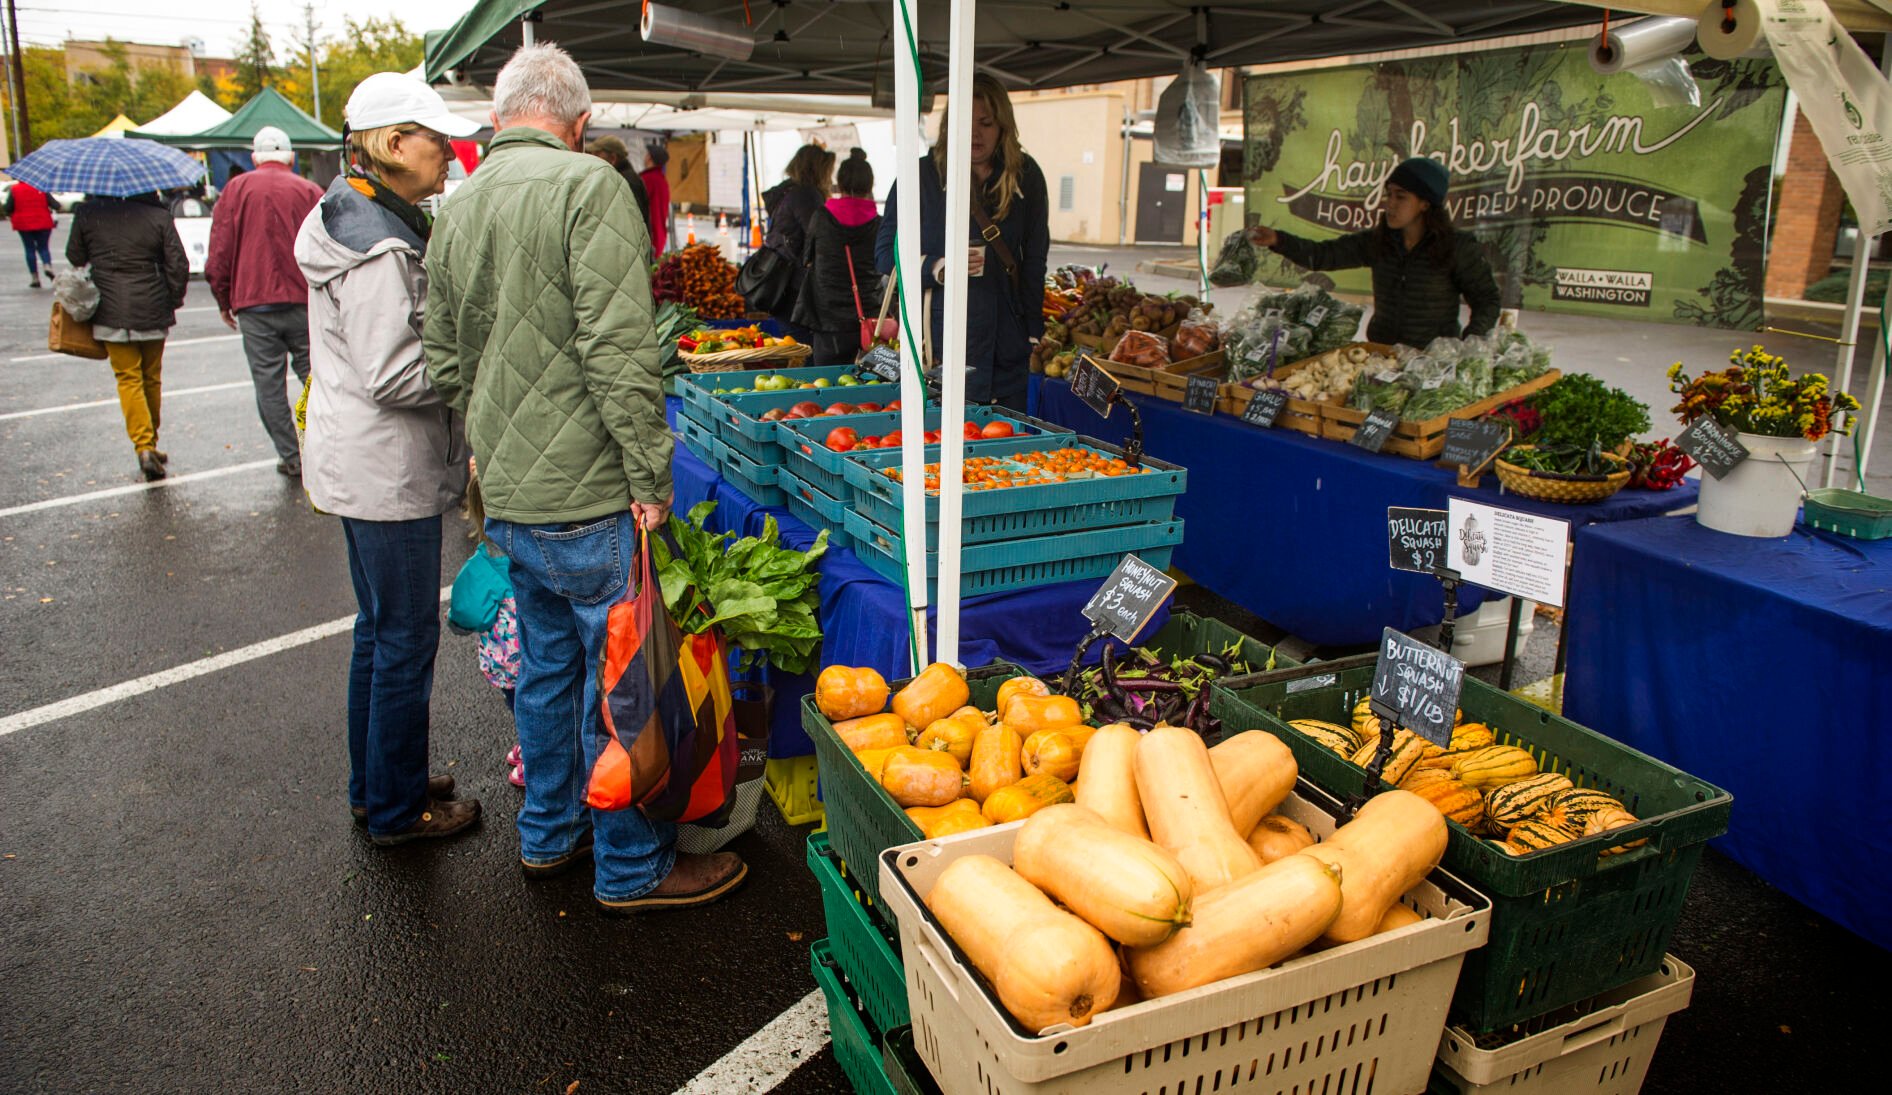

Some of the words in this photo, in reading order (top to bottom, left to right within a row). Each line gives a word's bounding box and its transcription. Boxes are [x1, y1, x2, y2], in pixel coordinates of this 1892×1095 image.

[1529, 185, 1666, 222] PRODUCE
[1558, 271, 1596, 284] WALLA
[1605, 273, 1647, 287] WALLA
[1556, 285, 1647, 303] WASHINGTON
[1254, 391, 1282, 407] GARLIC
[1389, 518, 1447, 539] DELICATA
[1401, 535, 1442, 549] SQUASH
[1121, 559, 1167, 591] HONEYNUT
[1119, 576, 1153, 602] SQUASH
[1099, 585, 1125, 610] $3
[1117, 606, 1138, 625] each
[1386, 638, 1464, 684] BUTTERNUT
[1396, 663, 1445, 694] SQUASH
